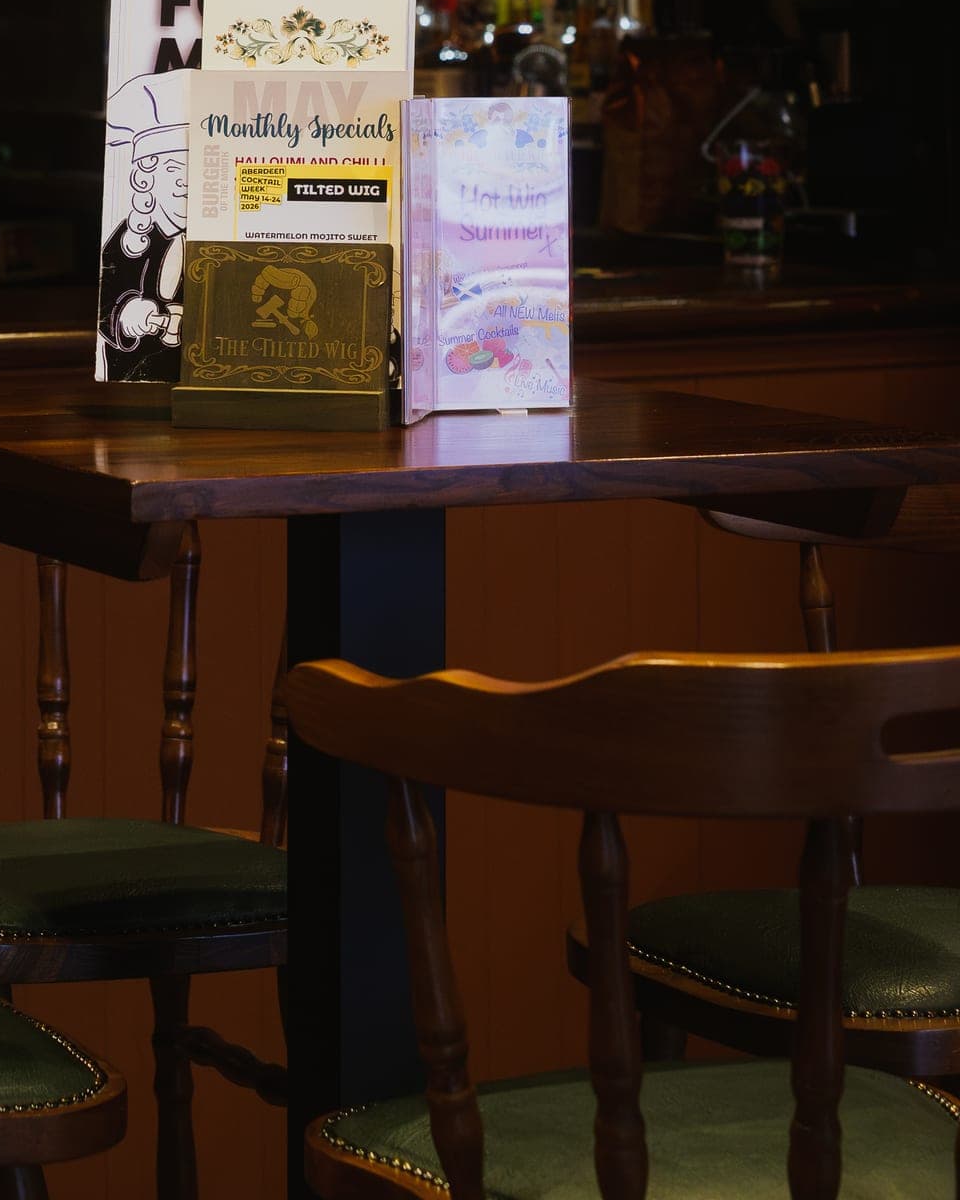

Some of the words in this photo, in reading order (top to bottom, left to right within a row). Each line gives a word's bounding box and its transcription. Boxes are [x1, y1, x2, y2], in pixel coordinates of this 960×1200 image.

[233, 81, 368, 128] MAY
[200, 113, 301, 148] Monthly
[308, 113, 396, 147] Specials
[201, 144, 220, 218] BURGER
[241, 176, 281, 186] COCKTAIL
[293, 184, 344, 195] TILTED
[348, 185, 381, 196] WIG
[240, 194, 260, 202] MAY
[261, 195, 281, 203] 14-24
[245, 232, 308, 240] WATERMELON
[310, 233, 346, 241] MOJITO
[494, 304, 507, 318] All
[510, 304, 535, 320] NEW
[439, 333, 475, 346] Summer
[216, 337, 249, 357] THE
[252, 337, 320, 360] TILTED
[322, 339, 358, 361] WIG
